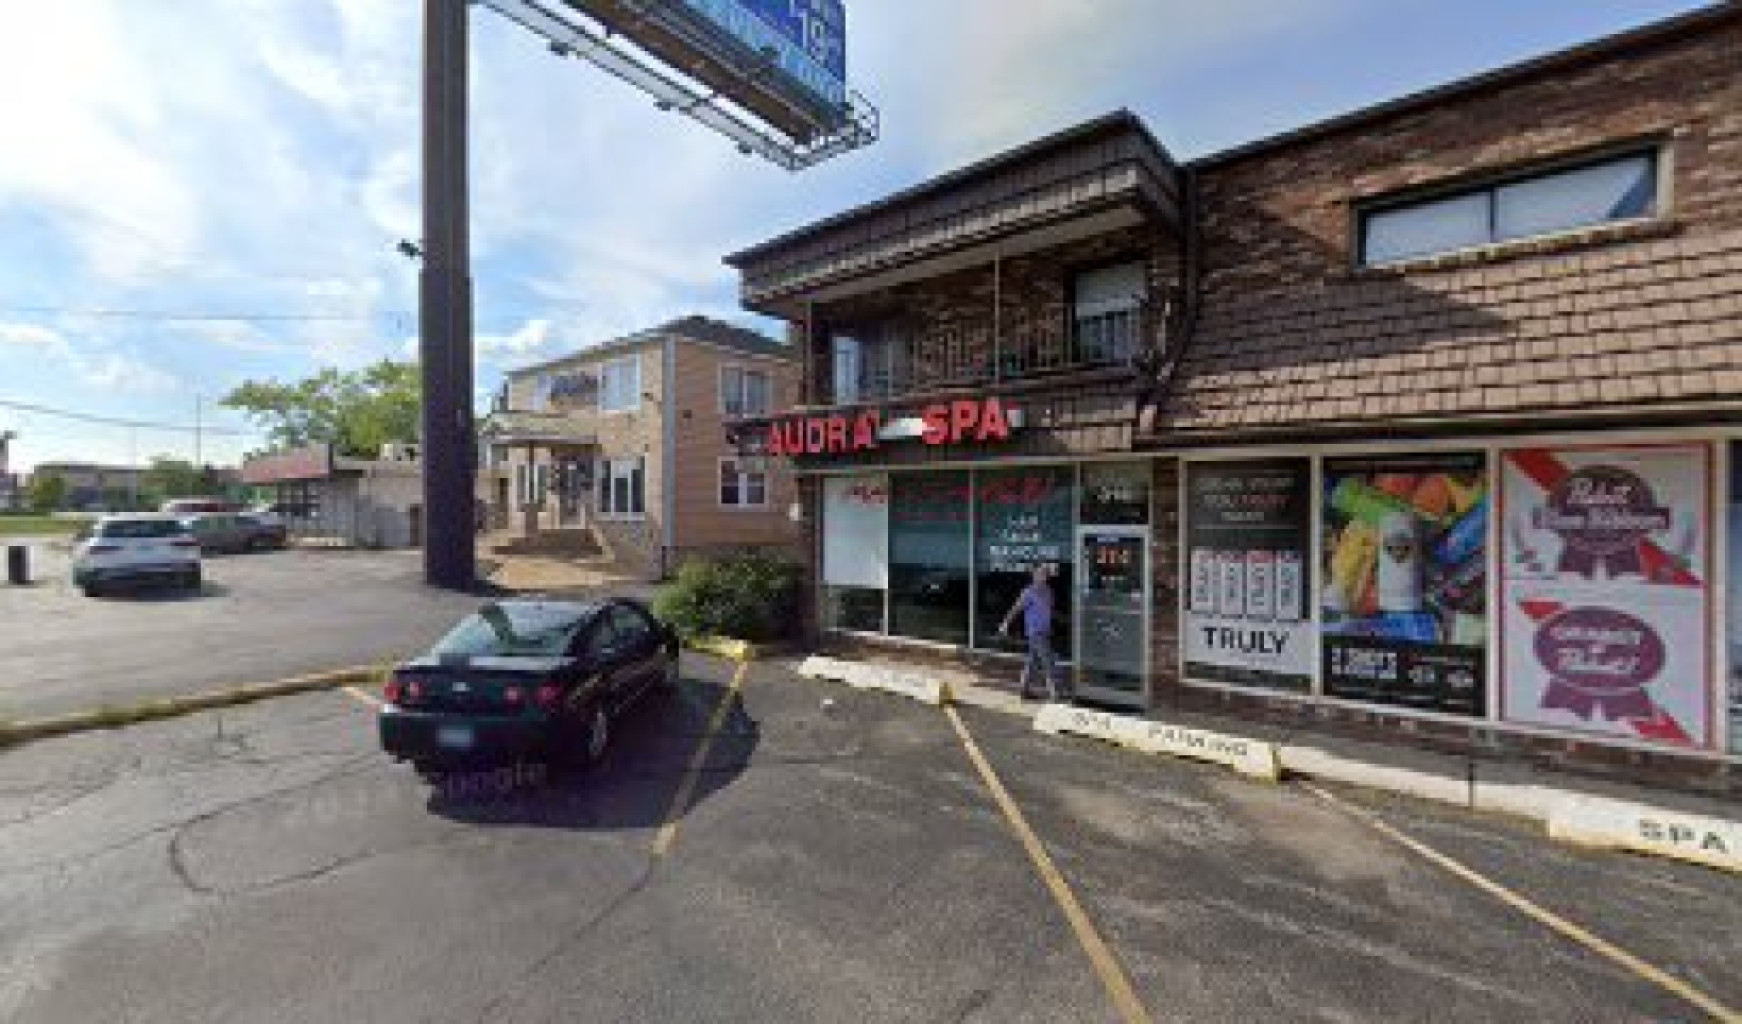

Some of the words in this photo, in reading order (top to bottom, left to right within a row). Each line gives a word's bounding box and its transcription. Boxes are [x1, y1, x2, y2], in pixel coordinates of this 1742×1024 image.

[921, 397, 1010, 445] SPA
[1203, 627, 1290, 653] TRULY
[1148, 722, 1248, 756] PARKING
[1639, 819, 1729, 853] SPA
